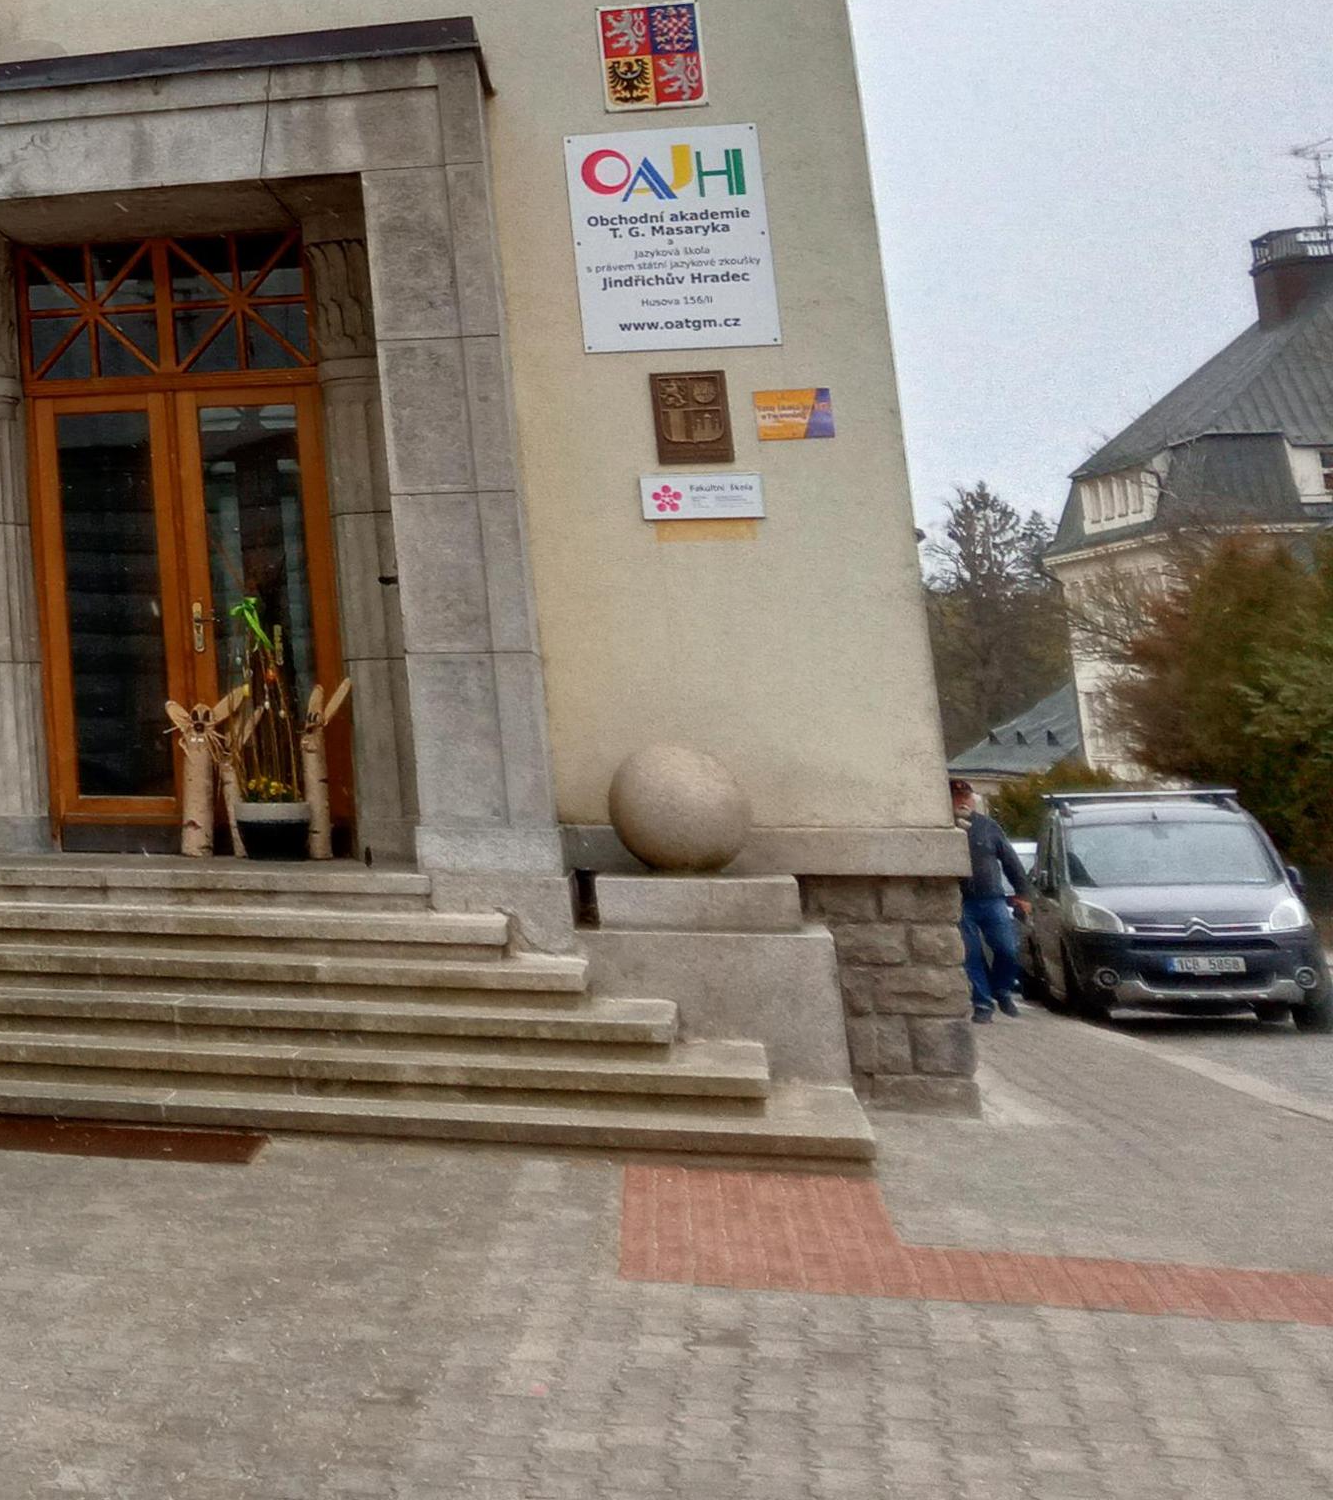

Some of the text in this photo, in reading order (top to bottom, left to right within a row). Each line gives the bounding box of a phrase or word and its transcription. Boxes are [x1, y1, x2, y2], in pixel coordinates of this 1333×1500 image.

[587, 207, 751, 227] Obchodní akademie
[609, 222, 731, 239] T. G. Masaryka
[684, 246, 711, 255] škola
[595, 263, 634, 274] právem
[637, 260, 667, 271] státní
[669, 258, 716, 270] jazykové
[718, 256, 761, 268] zkoušky
[602, 271, 750, 291] Jindřichův Hradec
[641, 298, 680, 307] Husova
[619, 317, 741, 332] www.oatgm.cz
